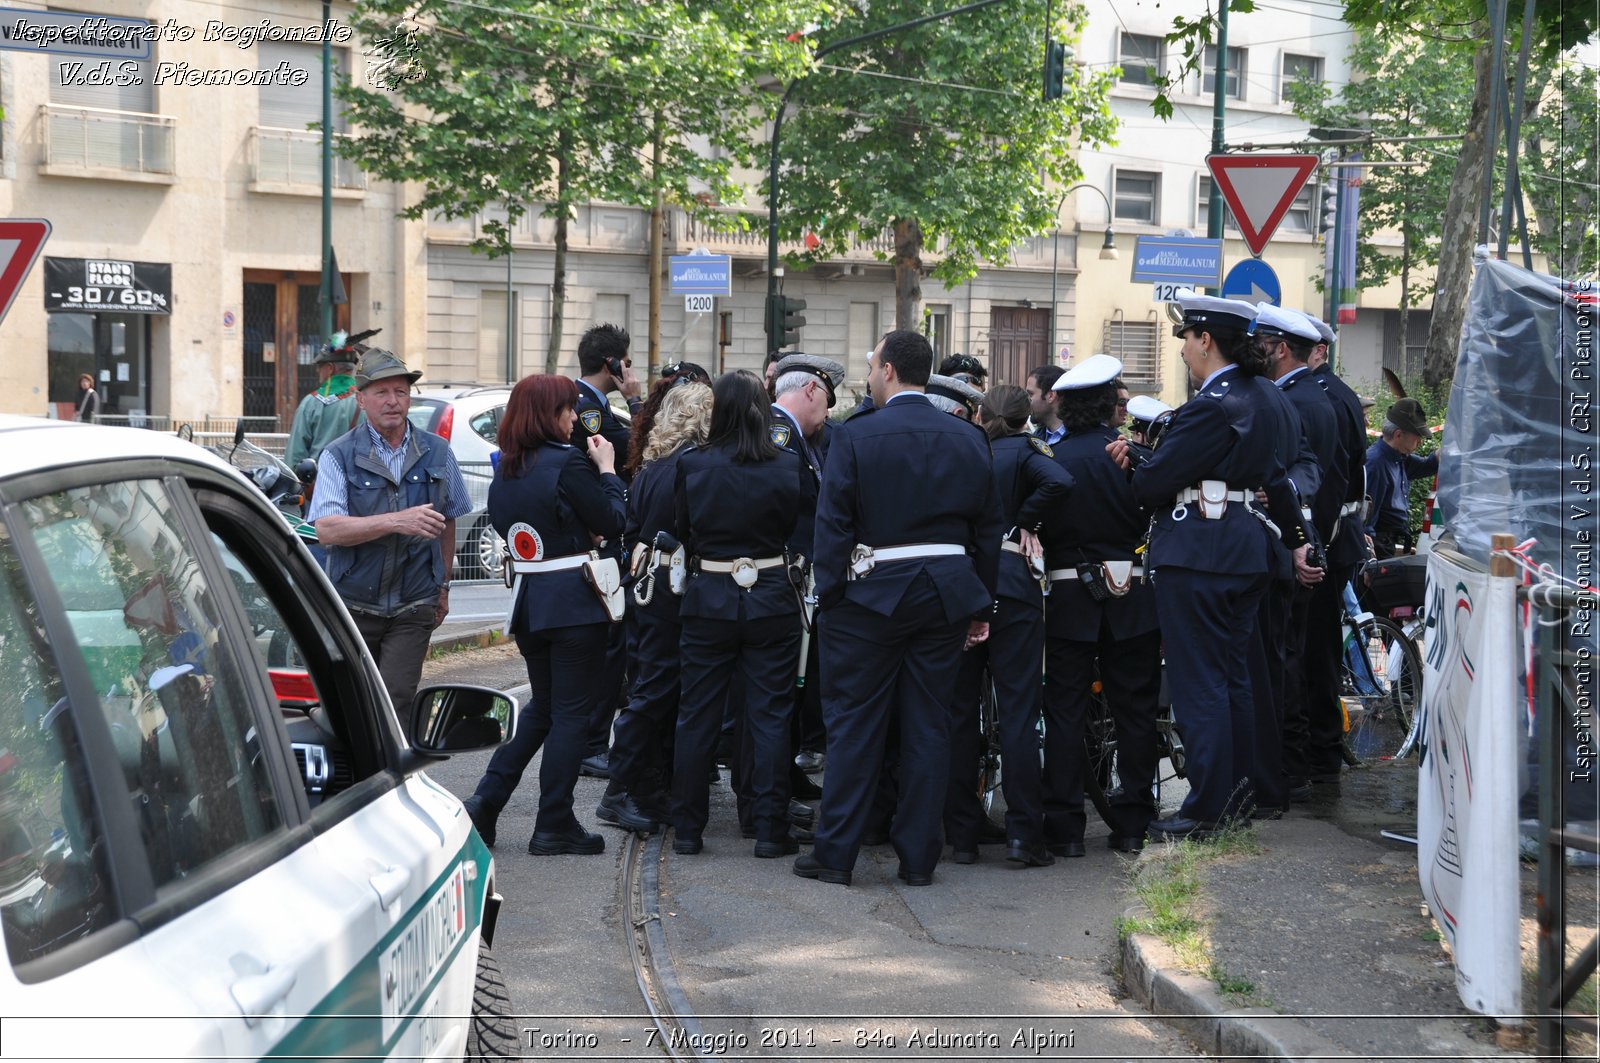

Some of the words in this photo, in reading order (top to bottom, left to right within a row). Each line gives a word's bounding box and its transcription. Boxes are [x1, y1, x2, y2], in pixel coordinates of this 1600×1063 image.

[1160, 257, 1216, 268] MEDIOLANUM
[89, 274, 131, 286] FLOOR
[688, 272, 727, 281] MEDIOLANUM
[68, 286, 101, 303] 30
[687, 296, 712, 310] 1200
